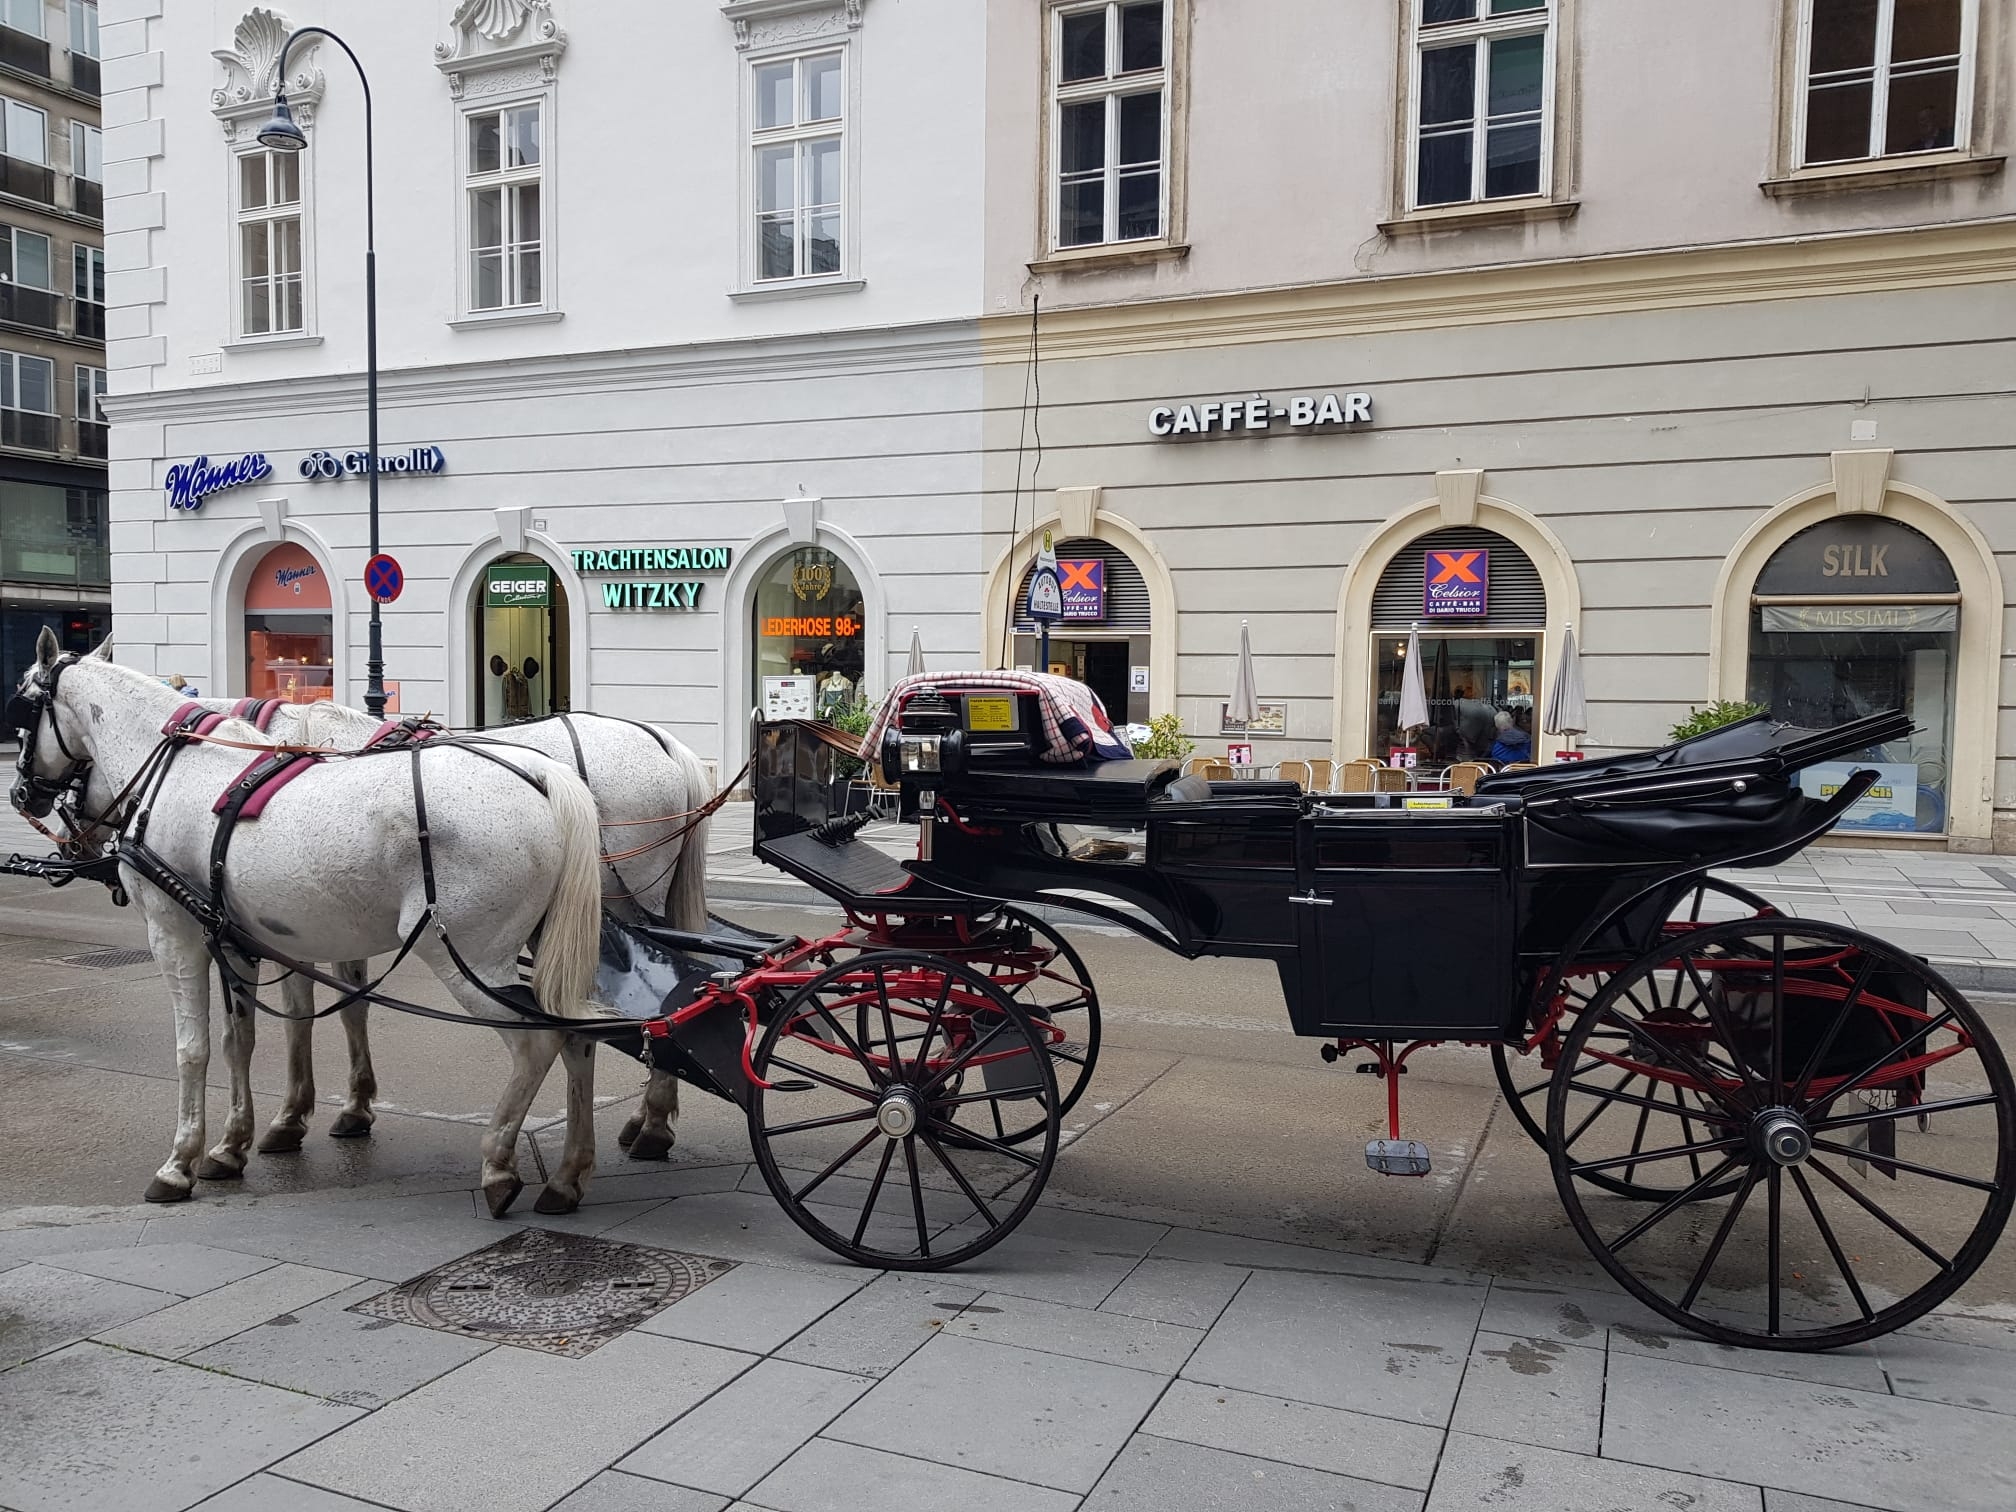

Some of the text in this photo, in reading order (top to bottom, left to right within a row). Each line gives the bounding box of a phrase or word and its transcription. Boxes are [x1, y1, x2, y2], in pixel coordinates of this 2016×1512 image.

[1148, 392, 1374, 436] CAFFÈ-BAR
[165, 453, 271, 510] Manner
[571, 548, 731, 571] TRACHTENSALON
[1822, 544, 1889, 577] SILK
[274, 565, 316, 586] Manner
[800, 567, 823, 581] 100
[490, 580, 547, 593] GEIGER
[800, 582, 823, 591] Jahre
[1038, 575, 1057, 593] AUTOBUS
[1428, 583, 1481, 598] Celsior
[602, 582, 704, 607] WITZKY
[1033, 600, 1059, 611] HALTESTELLE
[761, 617, 832, 636] LEDERHOSE
[1816, 610, 1899, 626] MISSIMI
